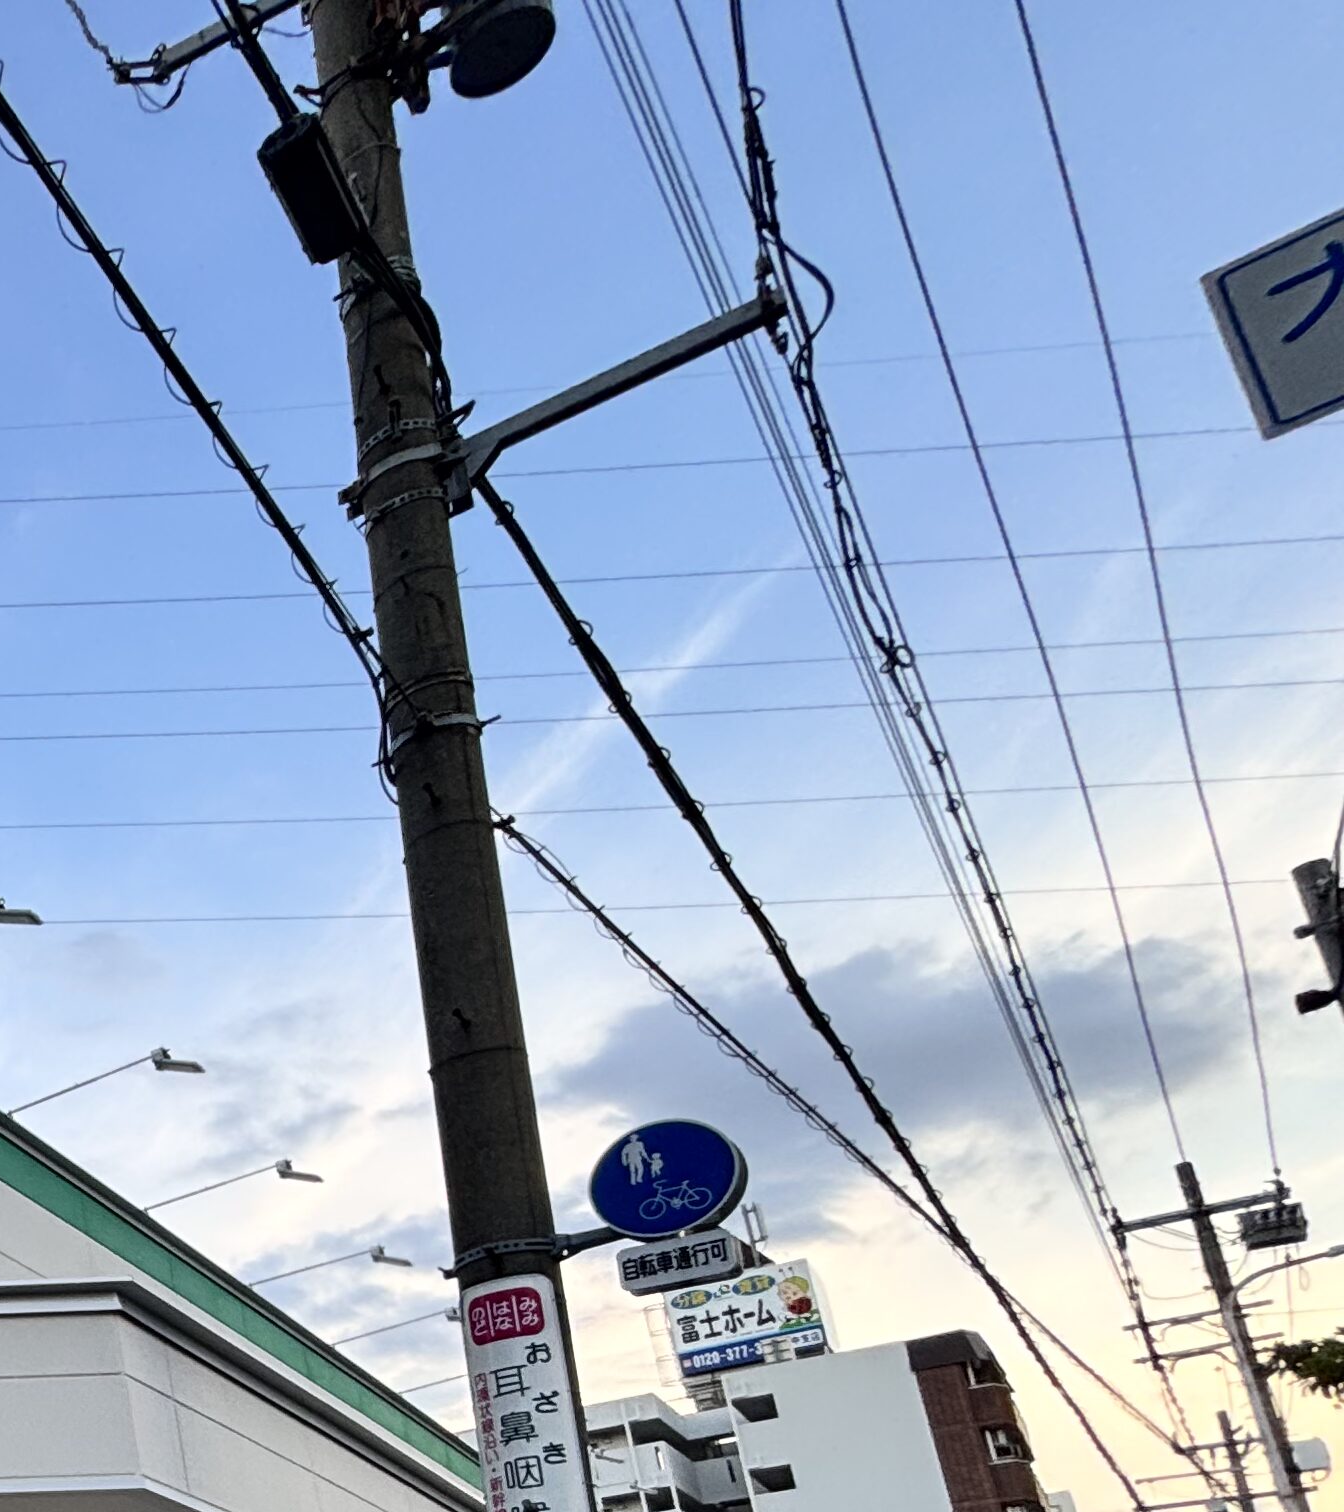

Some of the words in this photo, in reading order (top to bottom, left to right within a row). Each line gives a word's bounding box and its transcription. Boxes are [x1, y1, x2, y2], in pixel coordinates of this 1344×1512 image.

[622, 1238, 728, 1281] 自転車通行可
[471, 1307, 488, 1336] のど
[493, 1301, 513, 1330] はな
[519, 1297, 539, 1326] みみ
[677, 1299, 776, 1344] 富士ホーム
[693, 1342, 762, 1368] 0120-377-3
